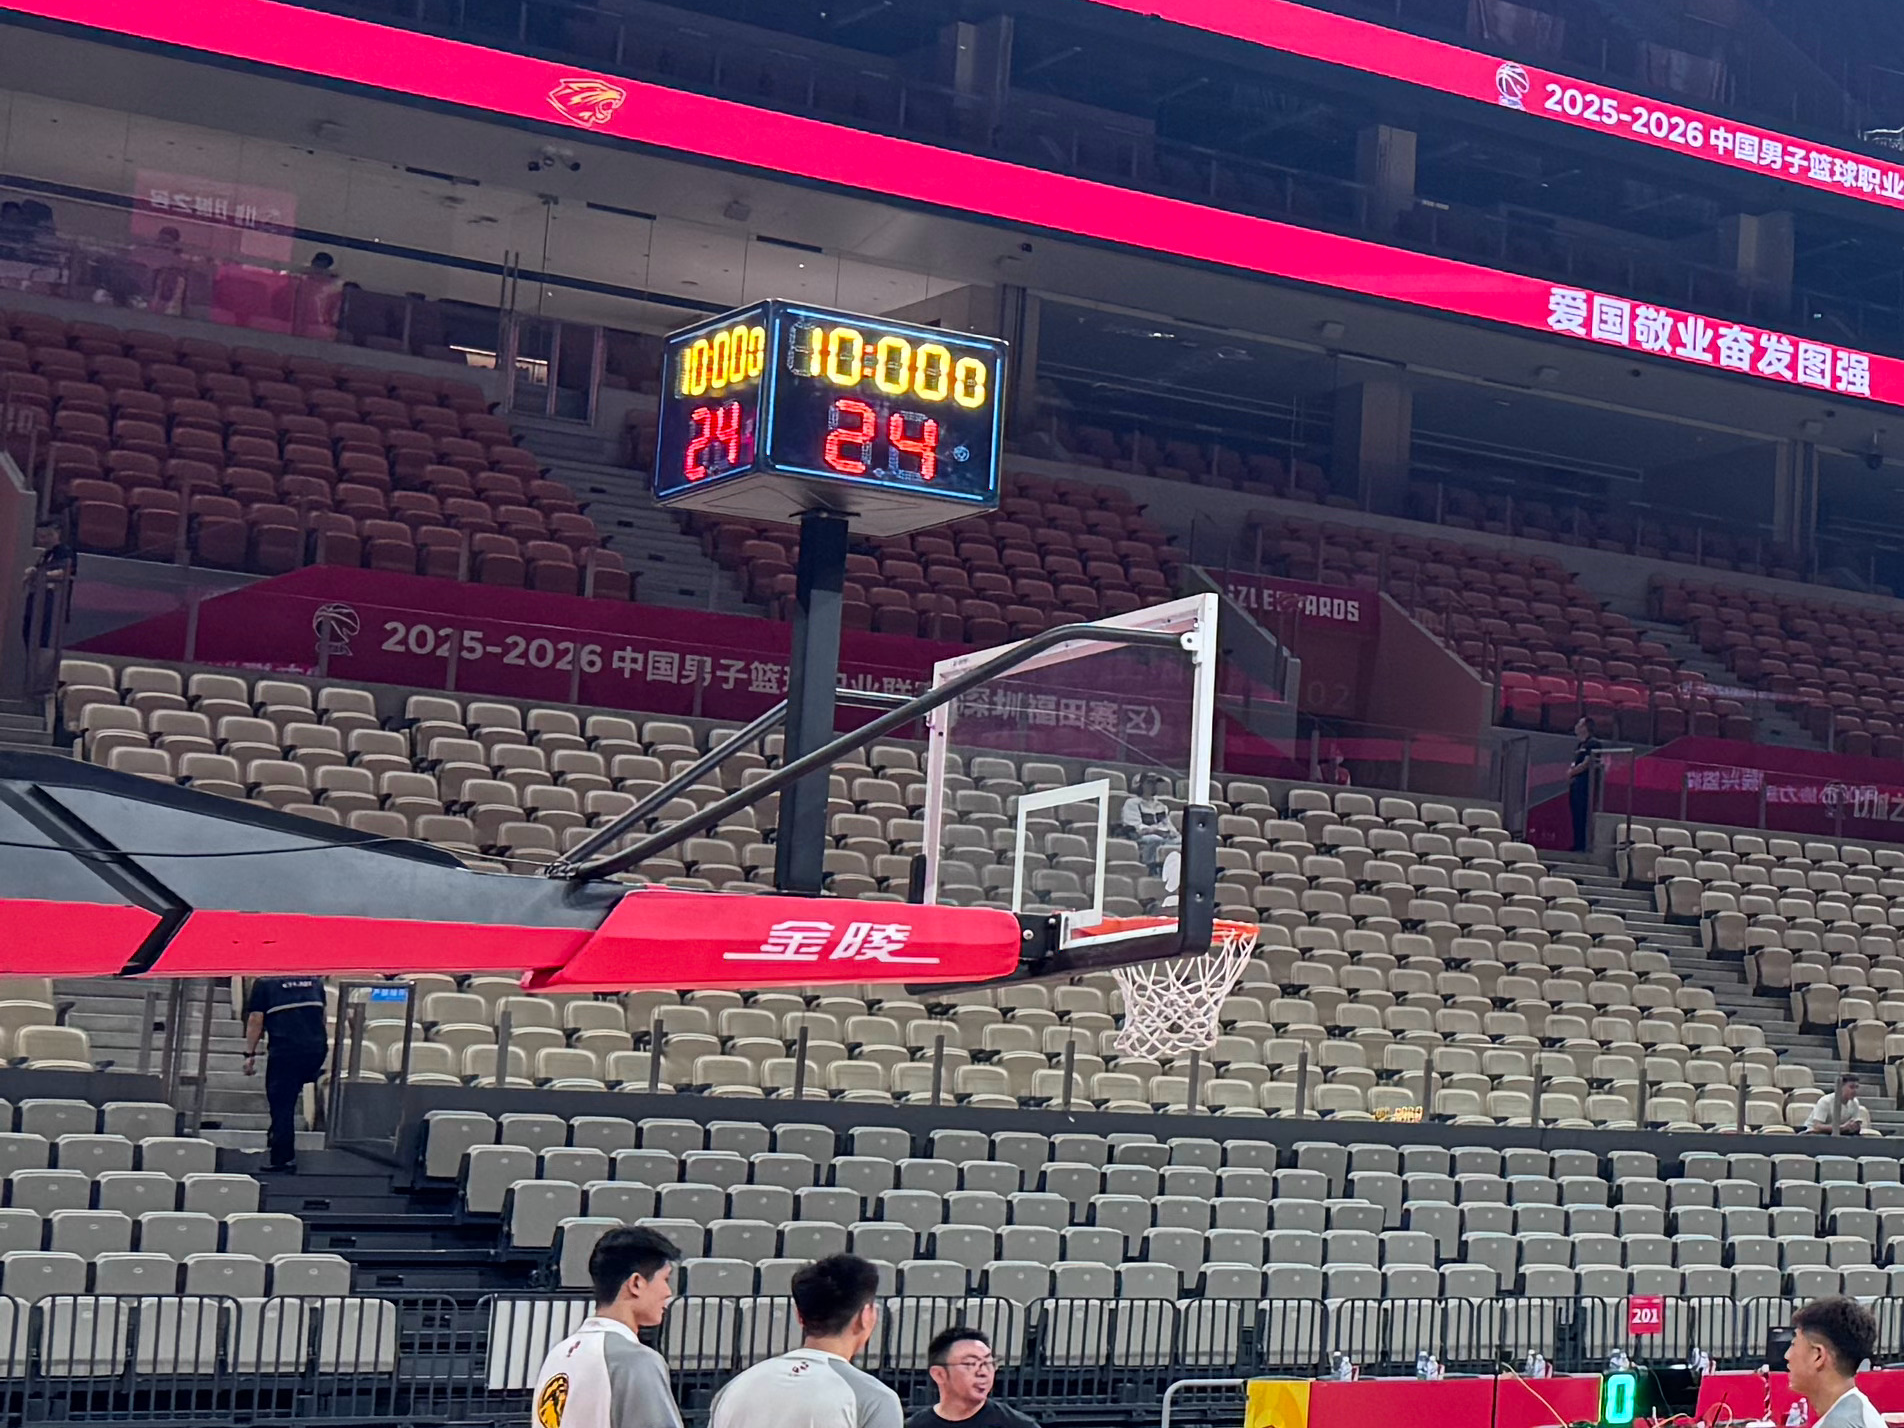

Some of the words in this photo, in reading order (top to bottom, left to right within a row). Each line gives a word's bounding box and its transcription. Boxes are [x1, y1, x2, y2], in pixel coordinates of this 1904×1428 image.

[1545, 83, 1703, 147] 2025-2026
[1548, 287, 1872, 398] 爱国敬业奋发图强
[686, 401, 740, 481] 24
[825, 399, 939, 480] 24
[759, 920, 913, 963] 金陵
[1631, 1308, 1659, 1325] 201
[1605, 1375, 1636, 1424] 0
